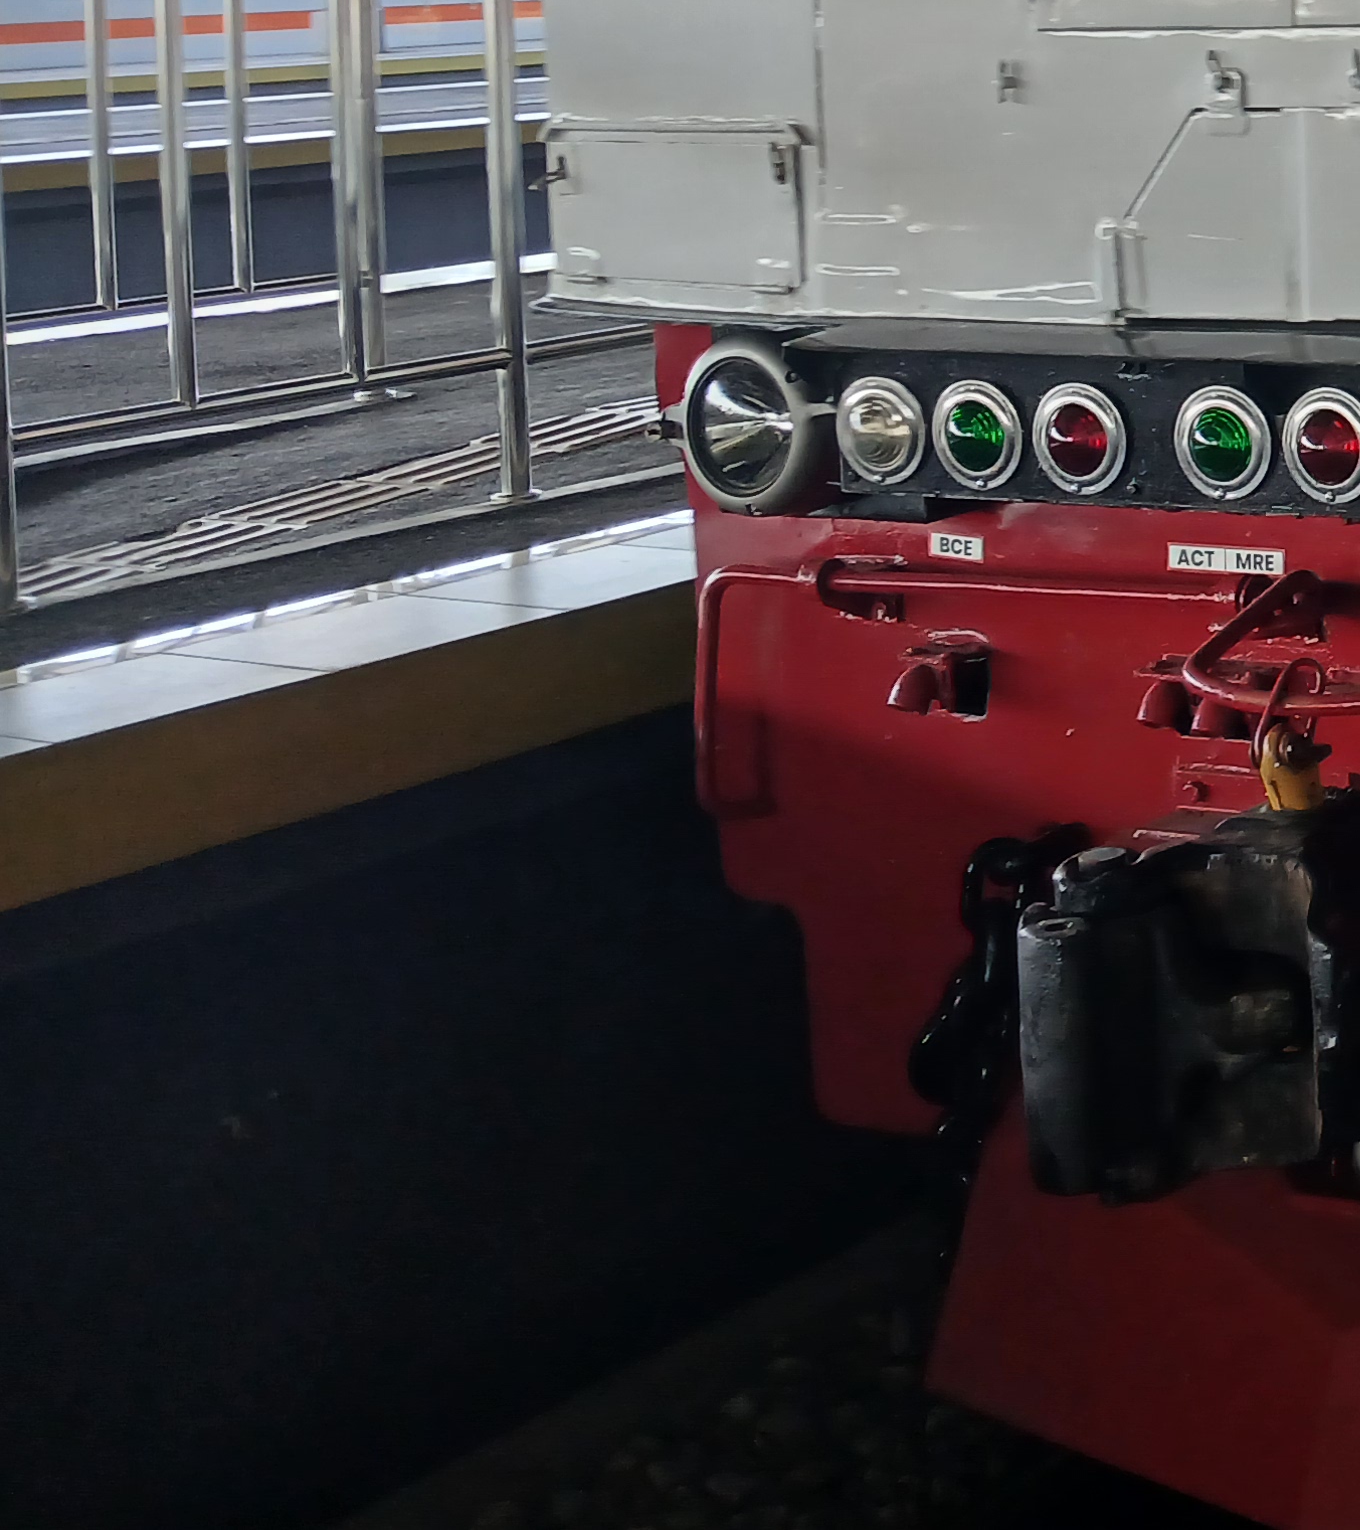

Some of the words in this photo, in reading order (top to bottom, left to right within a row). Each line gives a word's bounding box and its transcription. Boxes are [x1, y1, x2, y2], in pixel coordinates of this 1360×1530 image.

[939, 536, 973, 556] BCE
[1177, 549, 1215, 568] ACT
[1235, 553, 1275, 572] MRE
